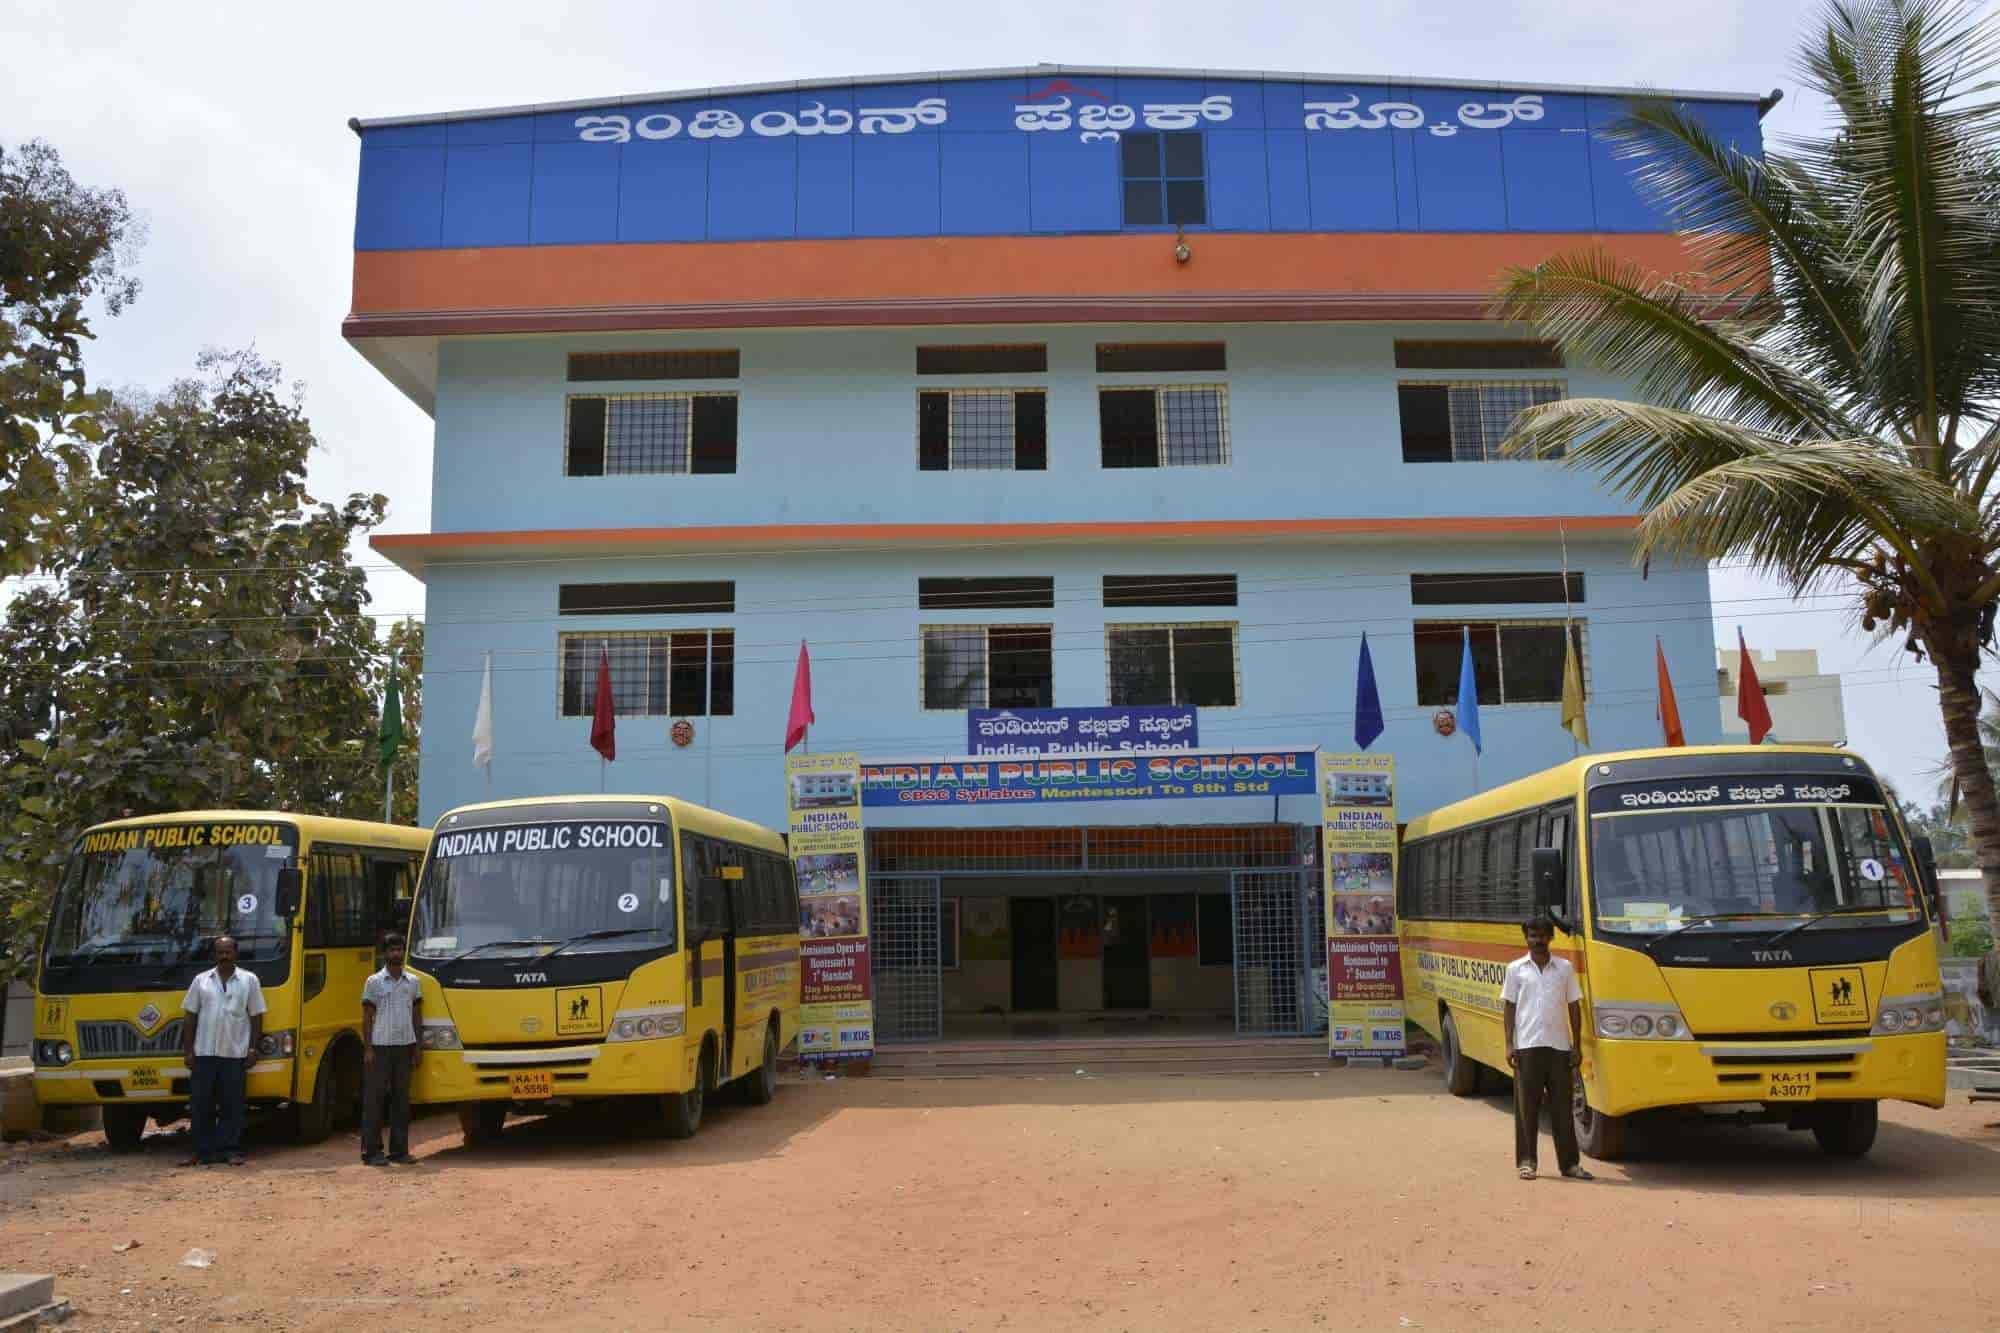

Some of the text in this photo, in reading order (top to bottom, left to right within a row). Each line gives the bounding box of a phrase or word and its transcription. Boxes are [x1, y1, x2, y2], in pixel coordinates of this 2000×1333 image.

[575, 98, 947, 143] ಇಂಡಿಯನ್
[1015, 96, 1233, 144] ಪಬ್ಲಿಕ್
[979, 716, 1069, 736] ಇಂಡಿಯನ್
[859, 753, 1308, 790] INDIAN PUBLIC SCHOOL
[956, 787, 1036, 805] Syllabus
[1620, 785, 1720, 806] ಇಂಡಿಯನ್
[1339, 811, 1382, 820] INDIAN
[83, 825, 283, 853] INDIAN PUBLIC SCHOOL
[436, 825, 663, 858] INDIAN PUBLIC SCHOOL
[242, 897, 252, 909] 3
[623, 895, 633, 909] 2
[1752, 951, 1793, 961] TATA
[513, 972, 547, 983] TATA
[1771, 1072, 1810, 1082] KA-11
[1770, 1084, 1811, 1097] A-3077
